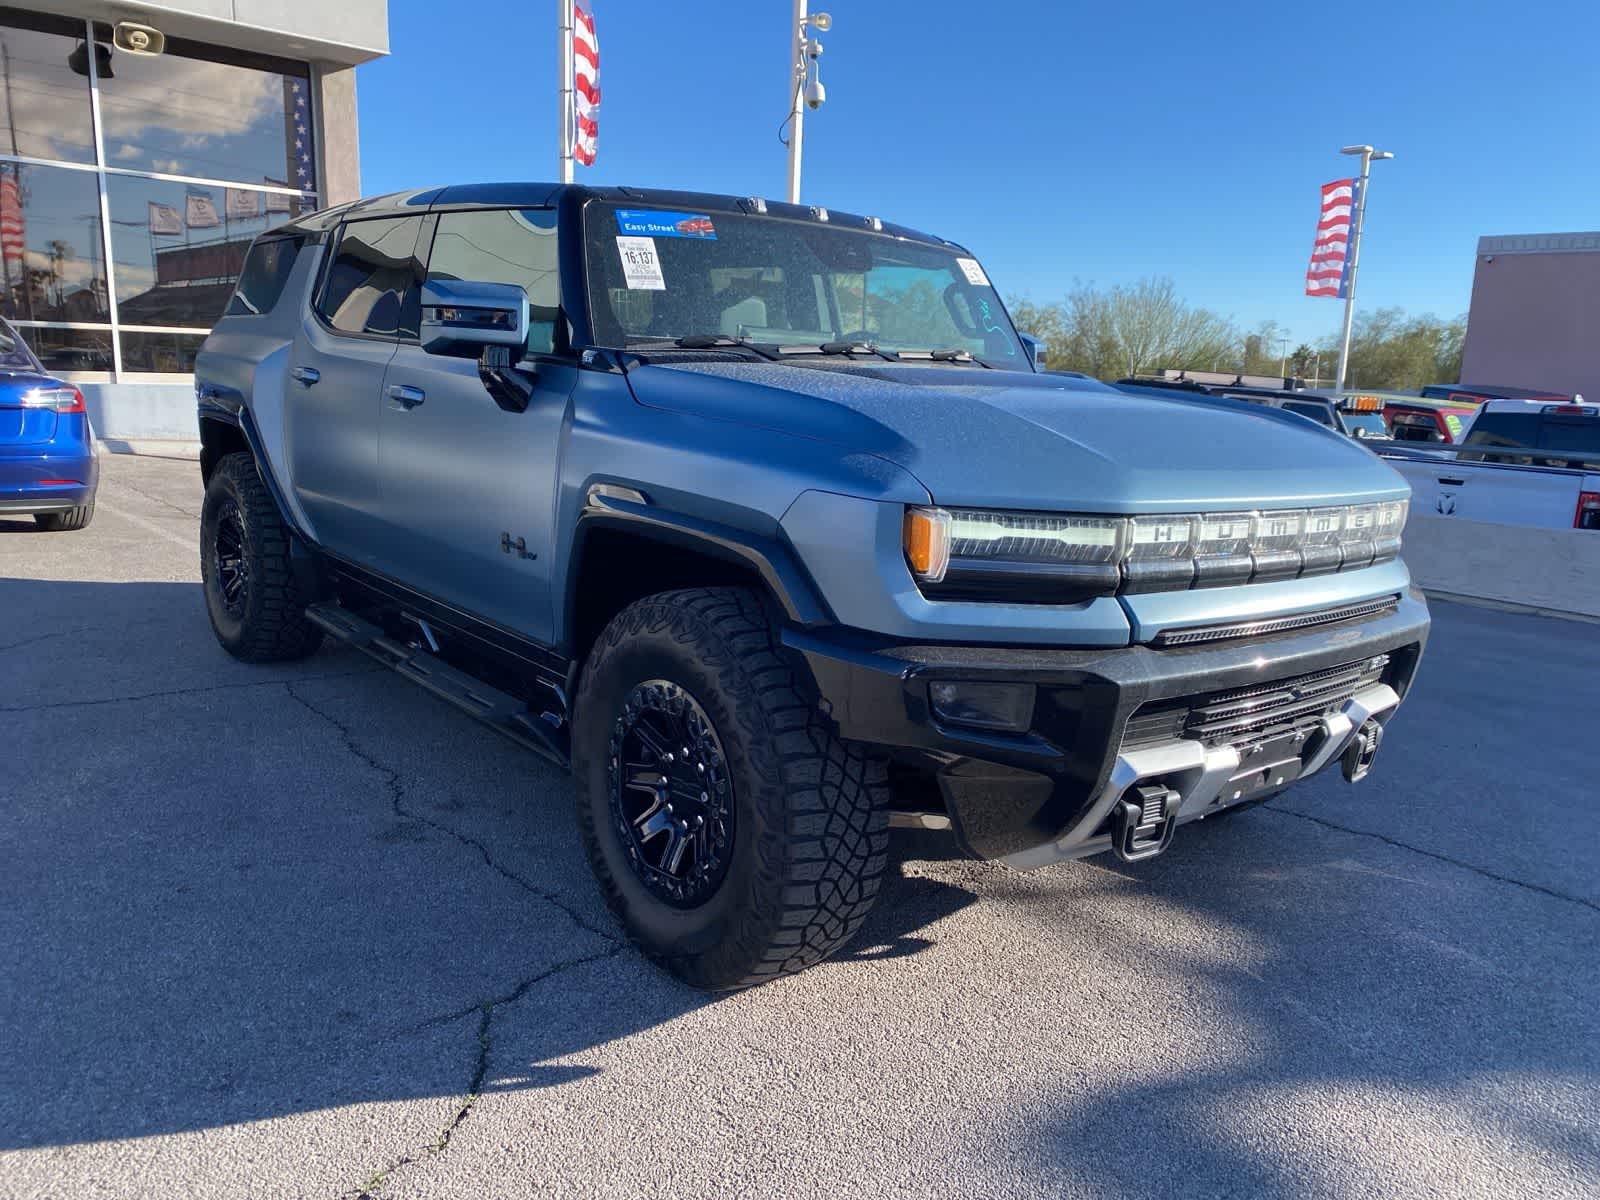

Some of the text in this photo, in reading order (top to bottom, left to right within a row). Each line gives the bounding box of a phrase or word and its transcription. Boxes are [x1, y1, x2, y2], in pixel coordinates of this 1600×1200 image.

[624, 223, 675, 232] Easy Street
[625, 251, 653, 264] 16:137
[1154, 509, 1394, 541] HUMMER
